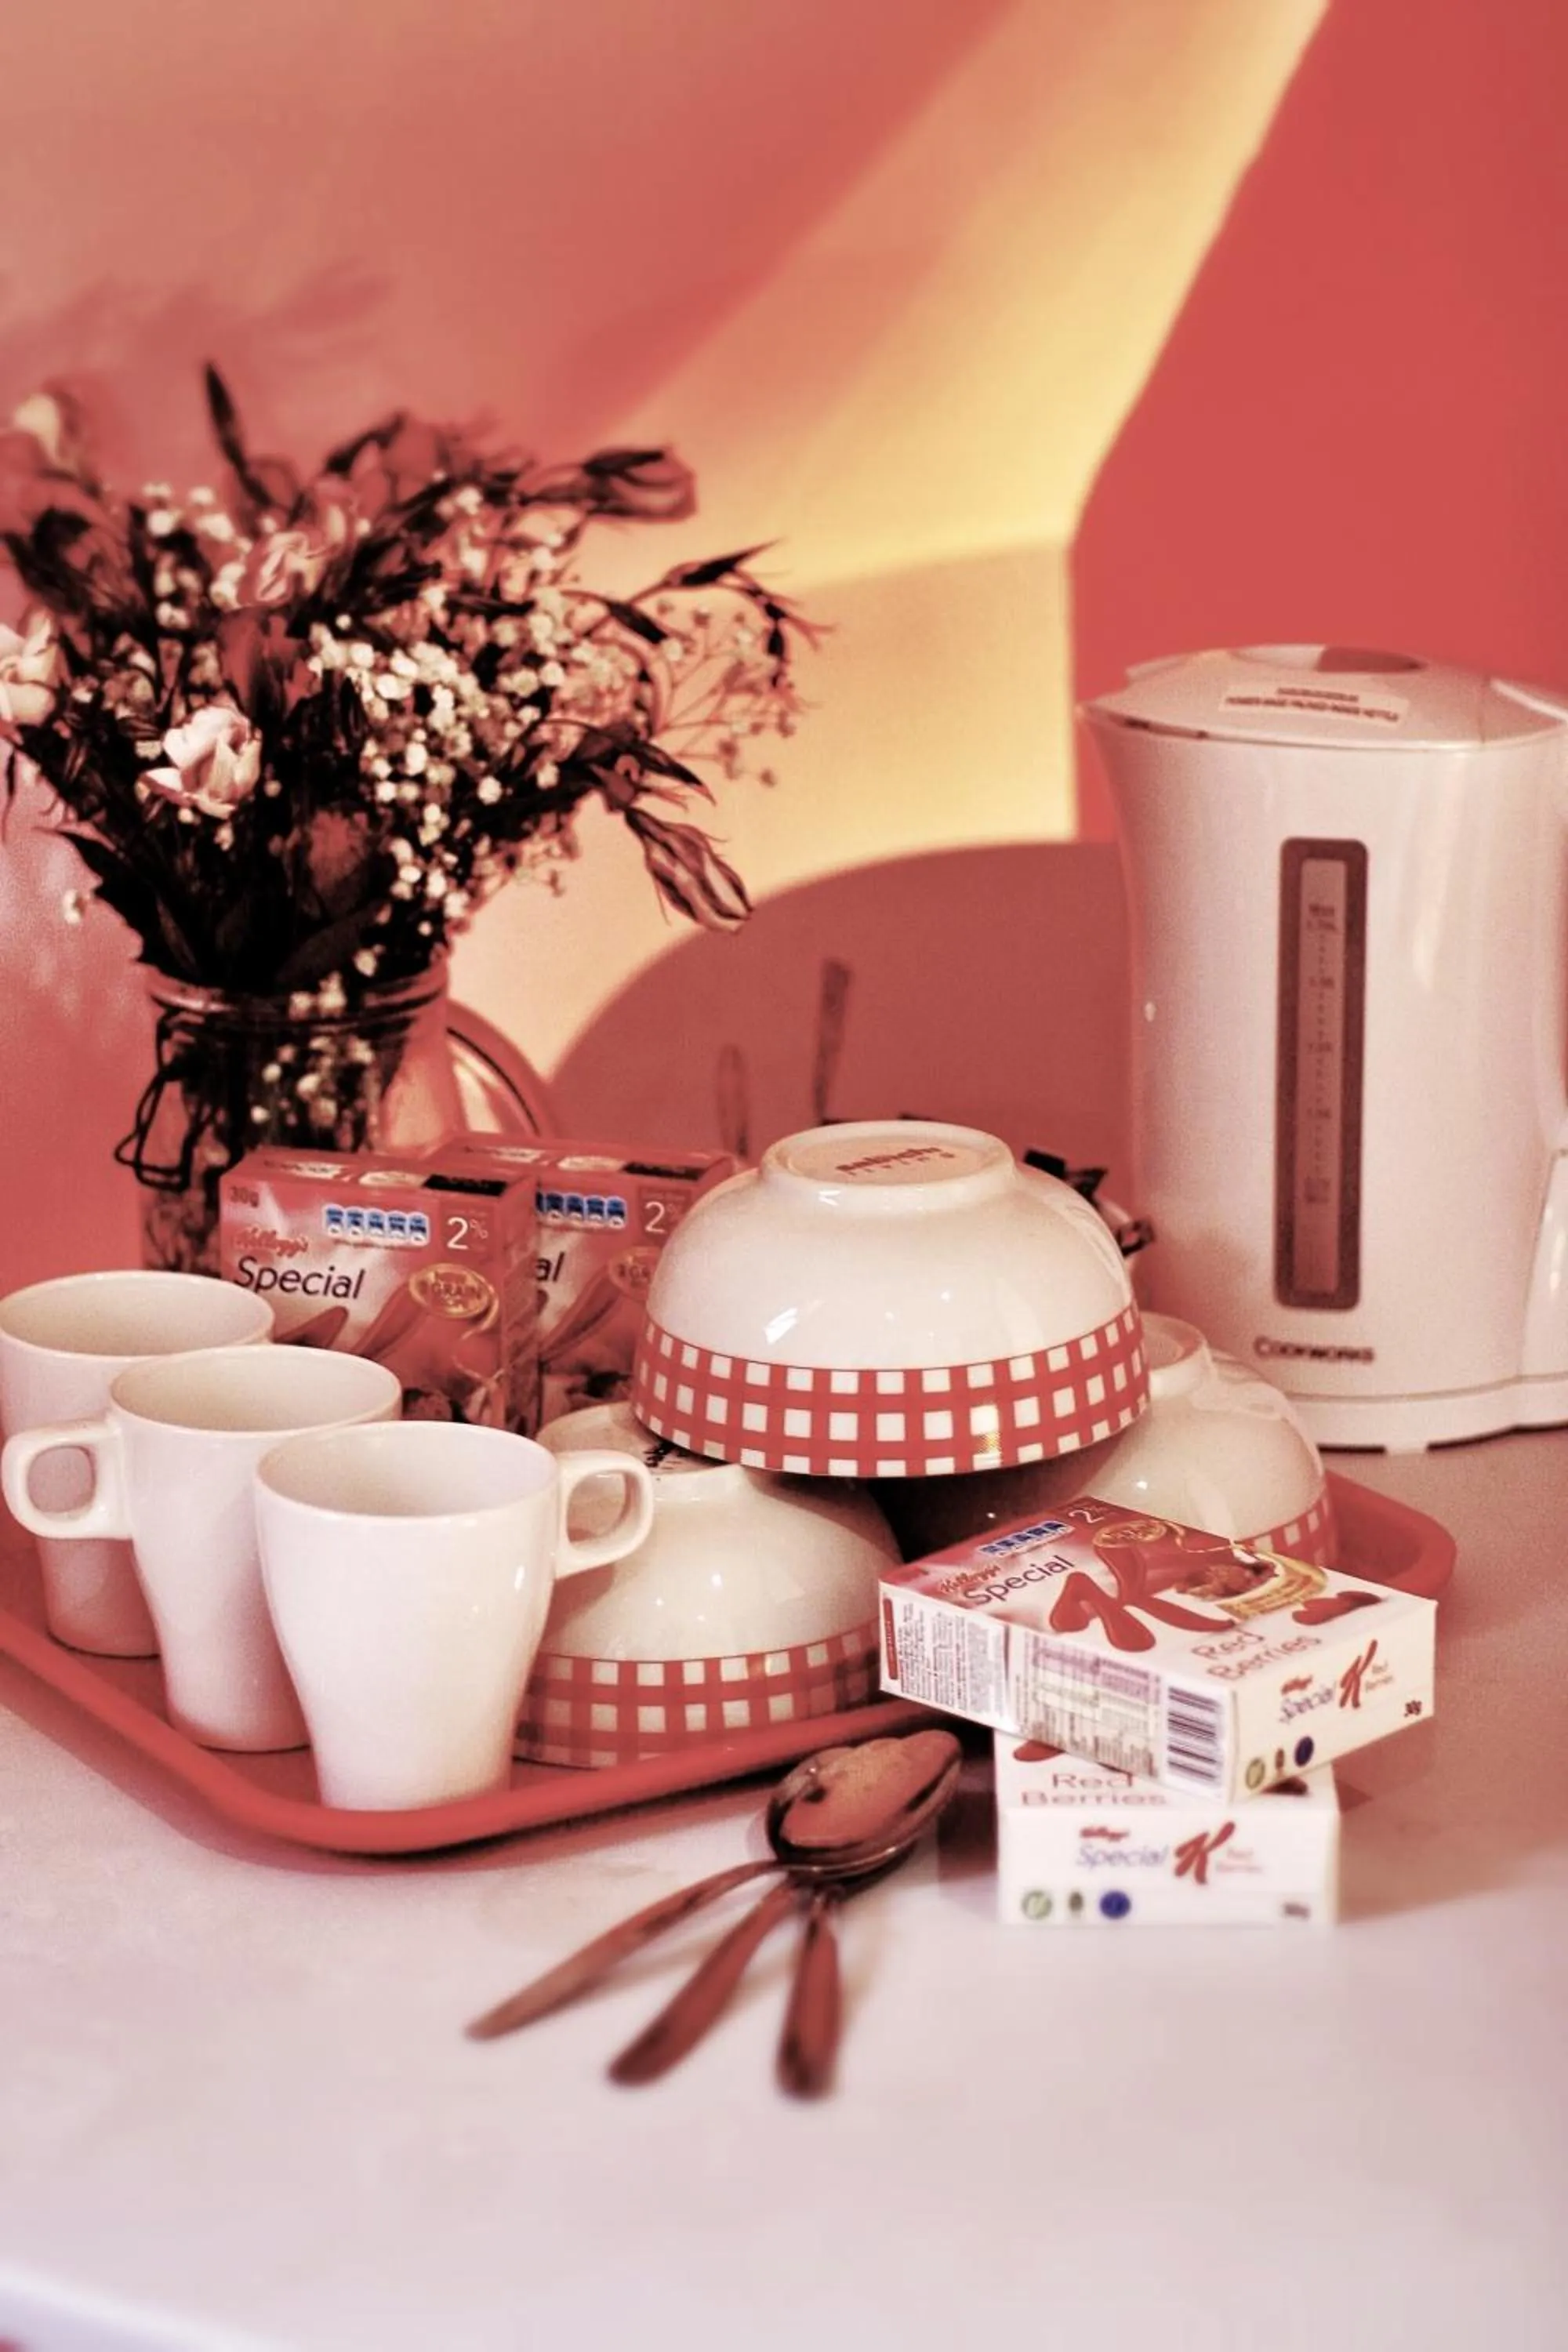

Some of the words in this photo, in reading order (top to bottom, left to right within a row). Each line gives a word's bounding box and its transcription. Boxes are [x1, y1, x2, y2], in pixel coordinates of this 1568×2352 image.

[235, 1255, 366, 1300] Special
[964, 1554, 1076, 1606] Special
[1190, 1626, 1265, 1661] Red
[1206, 1635, 1323, 1680] Berries
[1338, 1639, 1378, 1709] K
[1021, 1791, 1168, 1806] Berries
[1052, 1773, 1134, 1788] Red
[1076, 1844, 1169, 1873] Special
[1174, 1820, 1236, 1885] K
